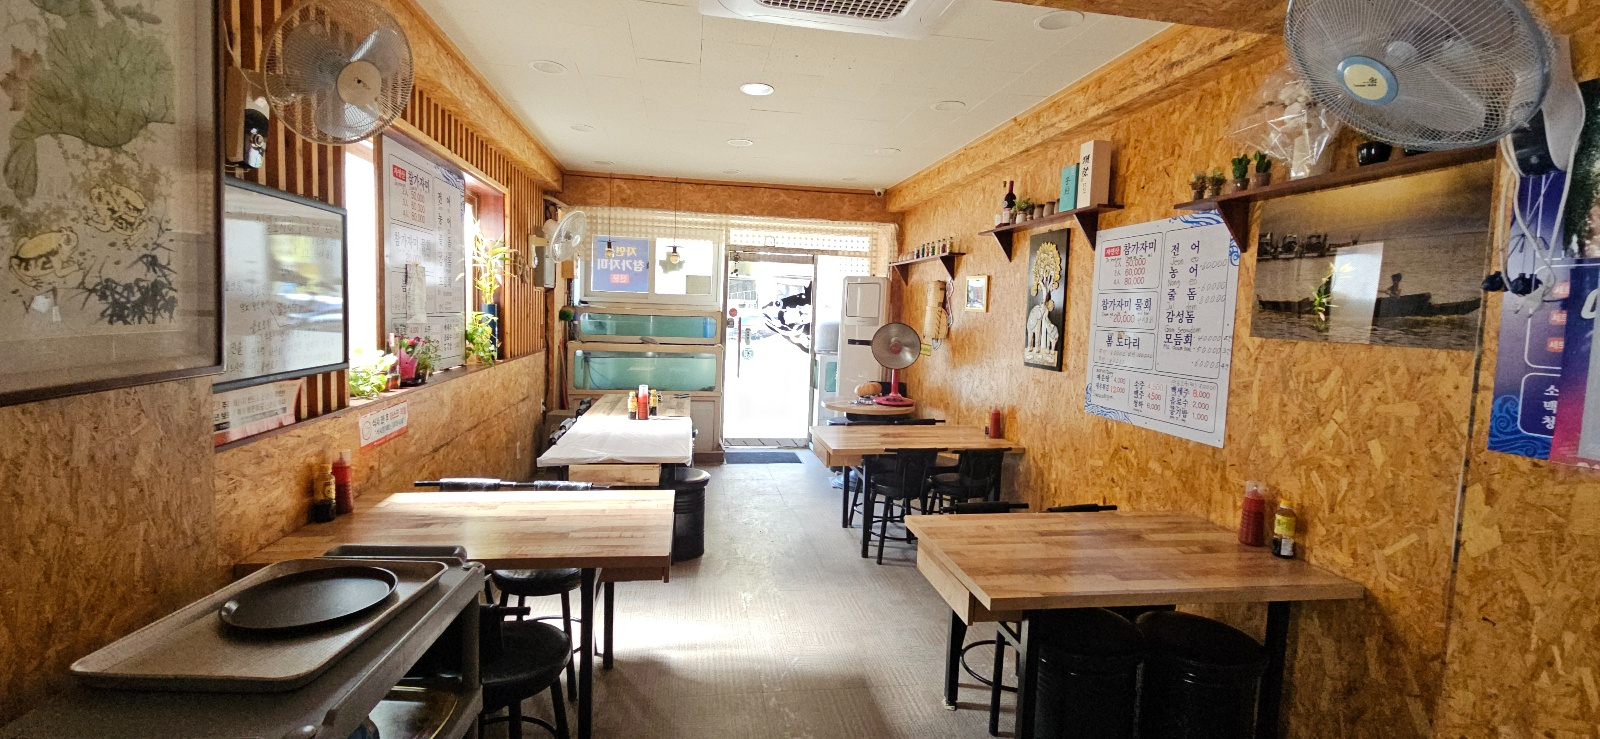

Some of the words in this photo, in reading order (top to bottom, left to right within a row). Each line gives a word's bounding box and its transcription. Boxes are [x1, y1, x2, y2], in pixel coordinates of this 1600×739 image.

[408, 171, 430, 193] 참가자미
[394, 231, 419, 250] 참가자미
[1123, 239, 1157, 256] 참가자미
[1170, 242, 1180, 256] 전
[1190, 240, 1200, 254] 어
[1125, 257, 1147, 268] 50,000
[1124, 267, 1146, 277] 60,000
[1169, 266, 1179, 279] 농
[1188, 263, 1199, 278] 어
[1123, 276, 1145, 286] 80,000
[1167, 288, 1177, 301] 줄
[1186, 287, 1198, 301] 돔
[1102, 298, 1131, 311] 참가자미
[1135, 297, 1152, 311] 물회
[1113, 313, 1135, 324] 20,000
[1165, 310, 1196, 324] 감성돔
[1106, 335, 1113, 347] 봄
[1116, 336, 1140, 350] 도다리
[1163, 333, 1193, 347] 모듬회
[1147, 402, 1161, 411] 6,000
